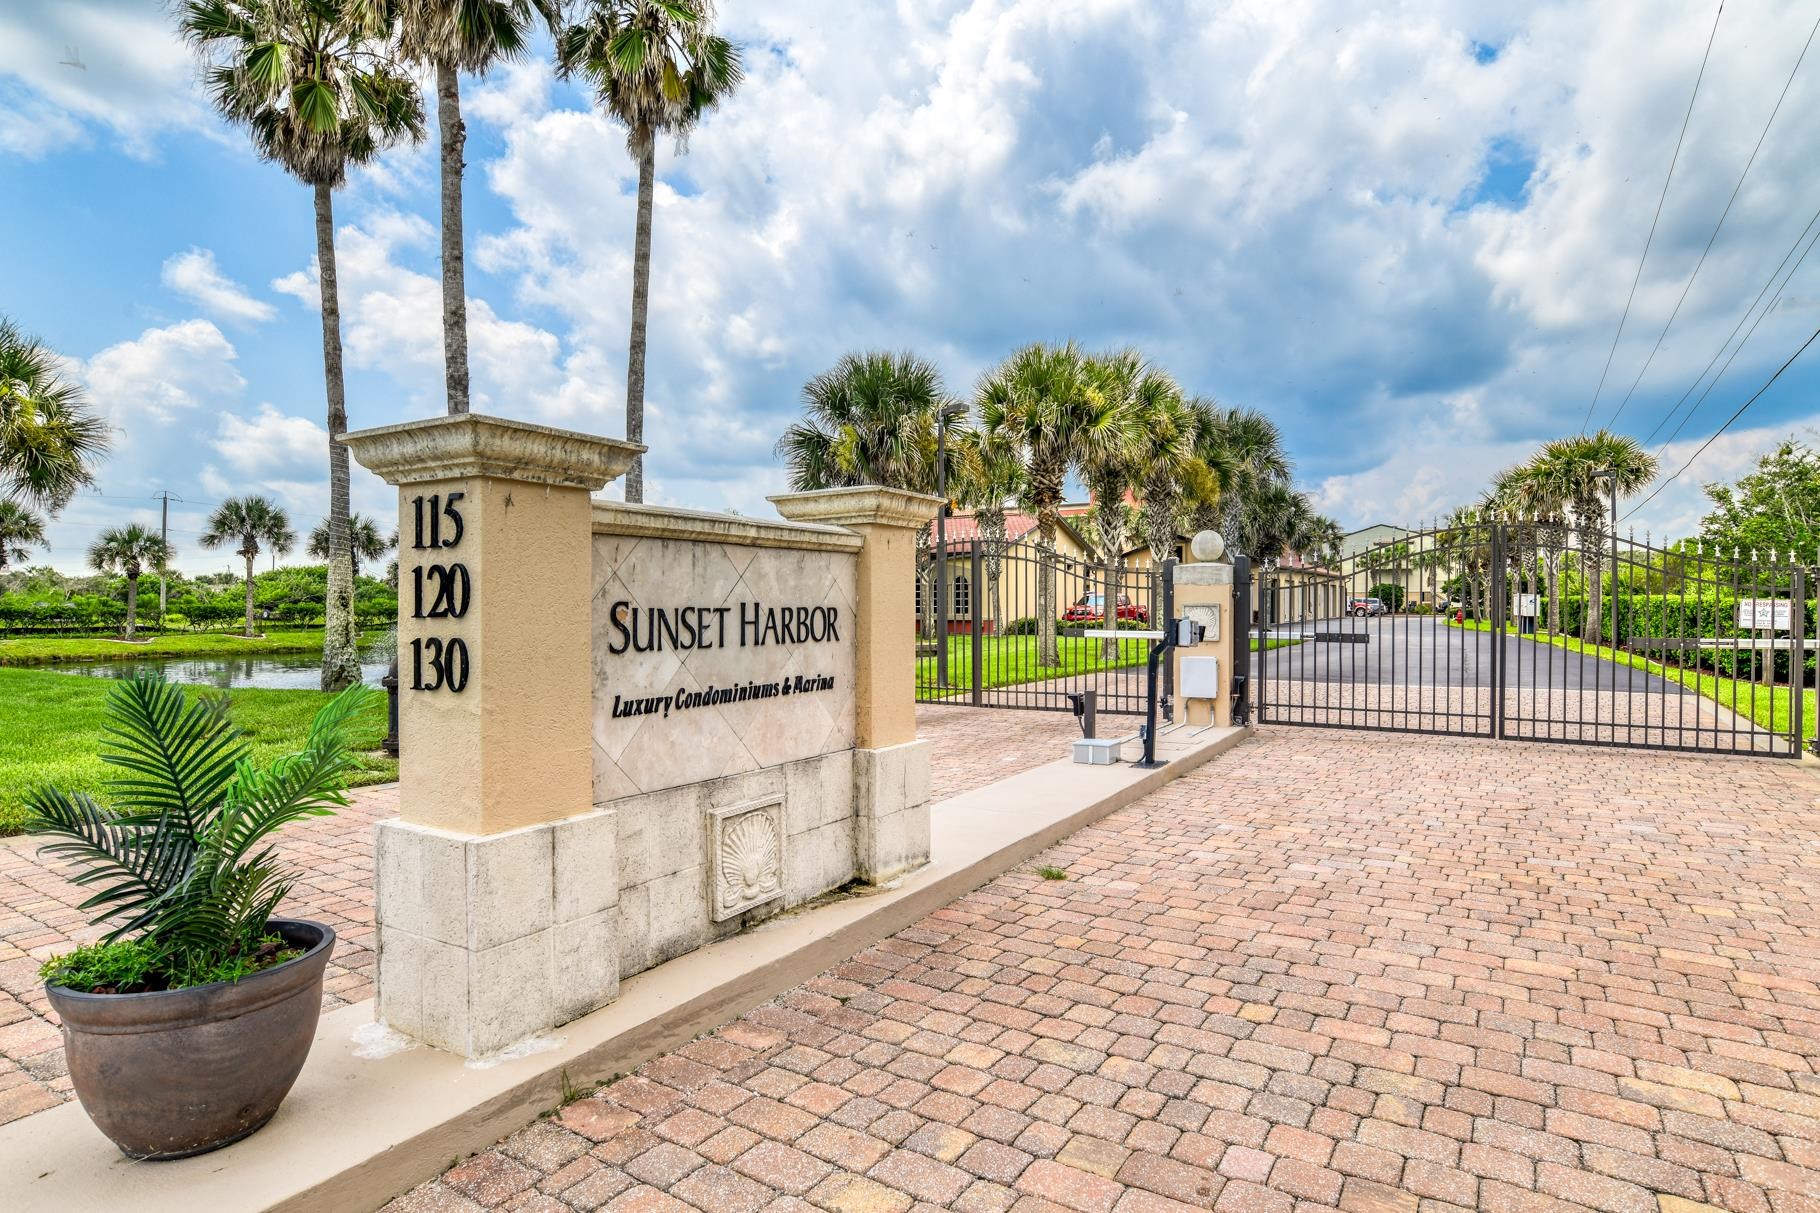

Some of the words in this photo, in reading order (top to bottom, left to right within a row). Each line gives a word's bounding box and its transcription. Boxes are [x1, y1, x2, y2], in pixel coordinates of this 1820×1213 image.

[412, 492, 465, 550] 115
[411, 563, 471, 619] 120
[609, 601, 731, 655] SUNSET
[740, 602, 840, 647] HARBOR
[410, 637, 470, 694] 130
[612, 695, 673, 718] Luxury
[675, 681, 780, 710] Condominiums
[781, 677, 791, 695] &
[793, 674, 835, 694] Marina
